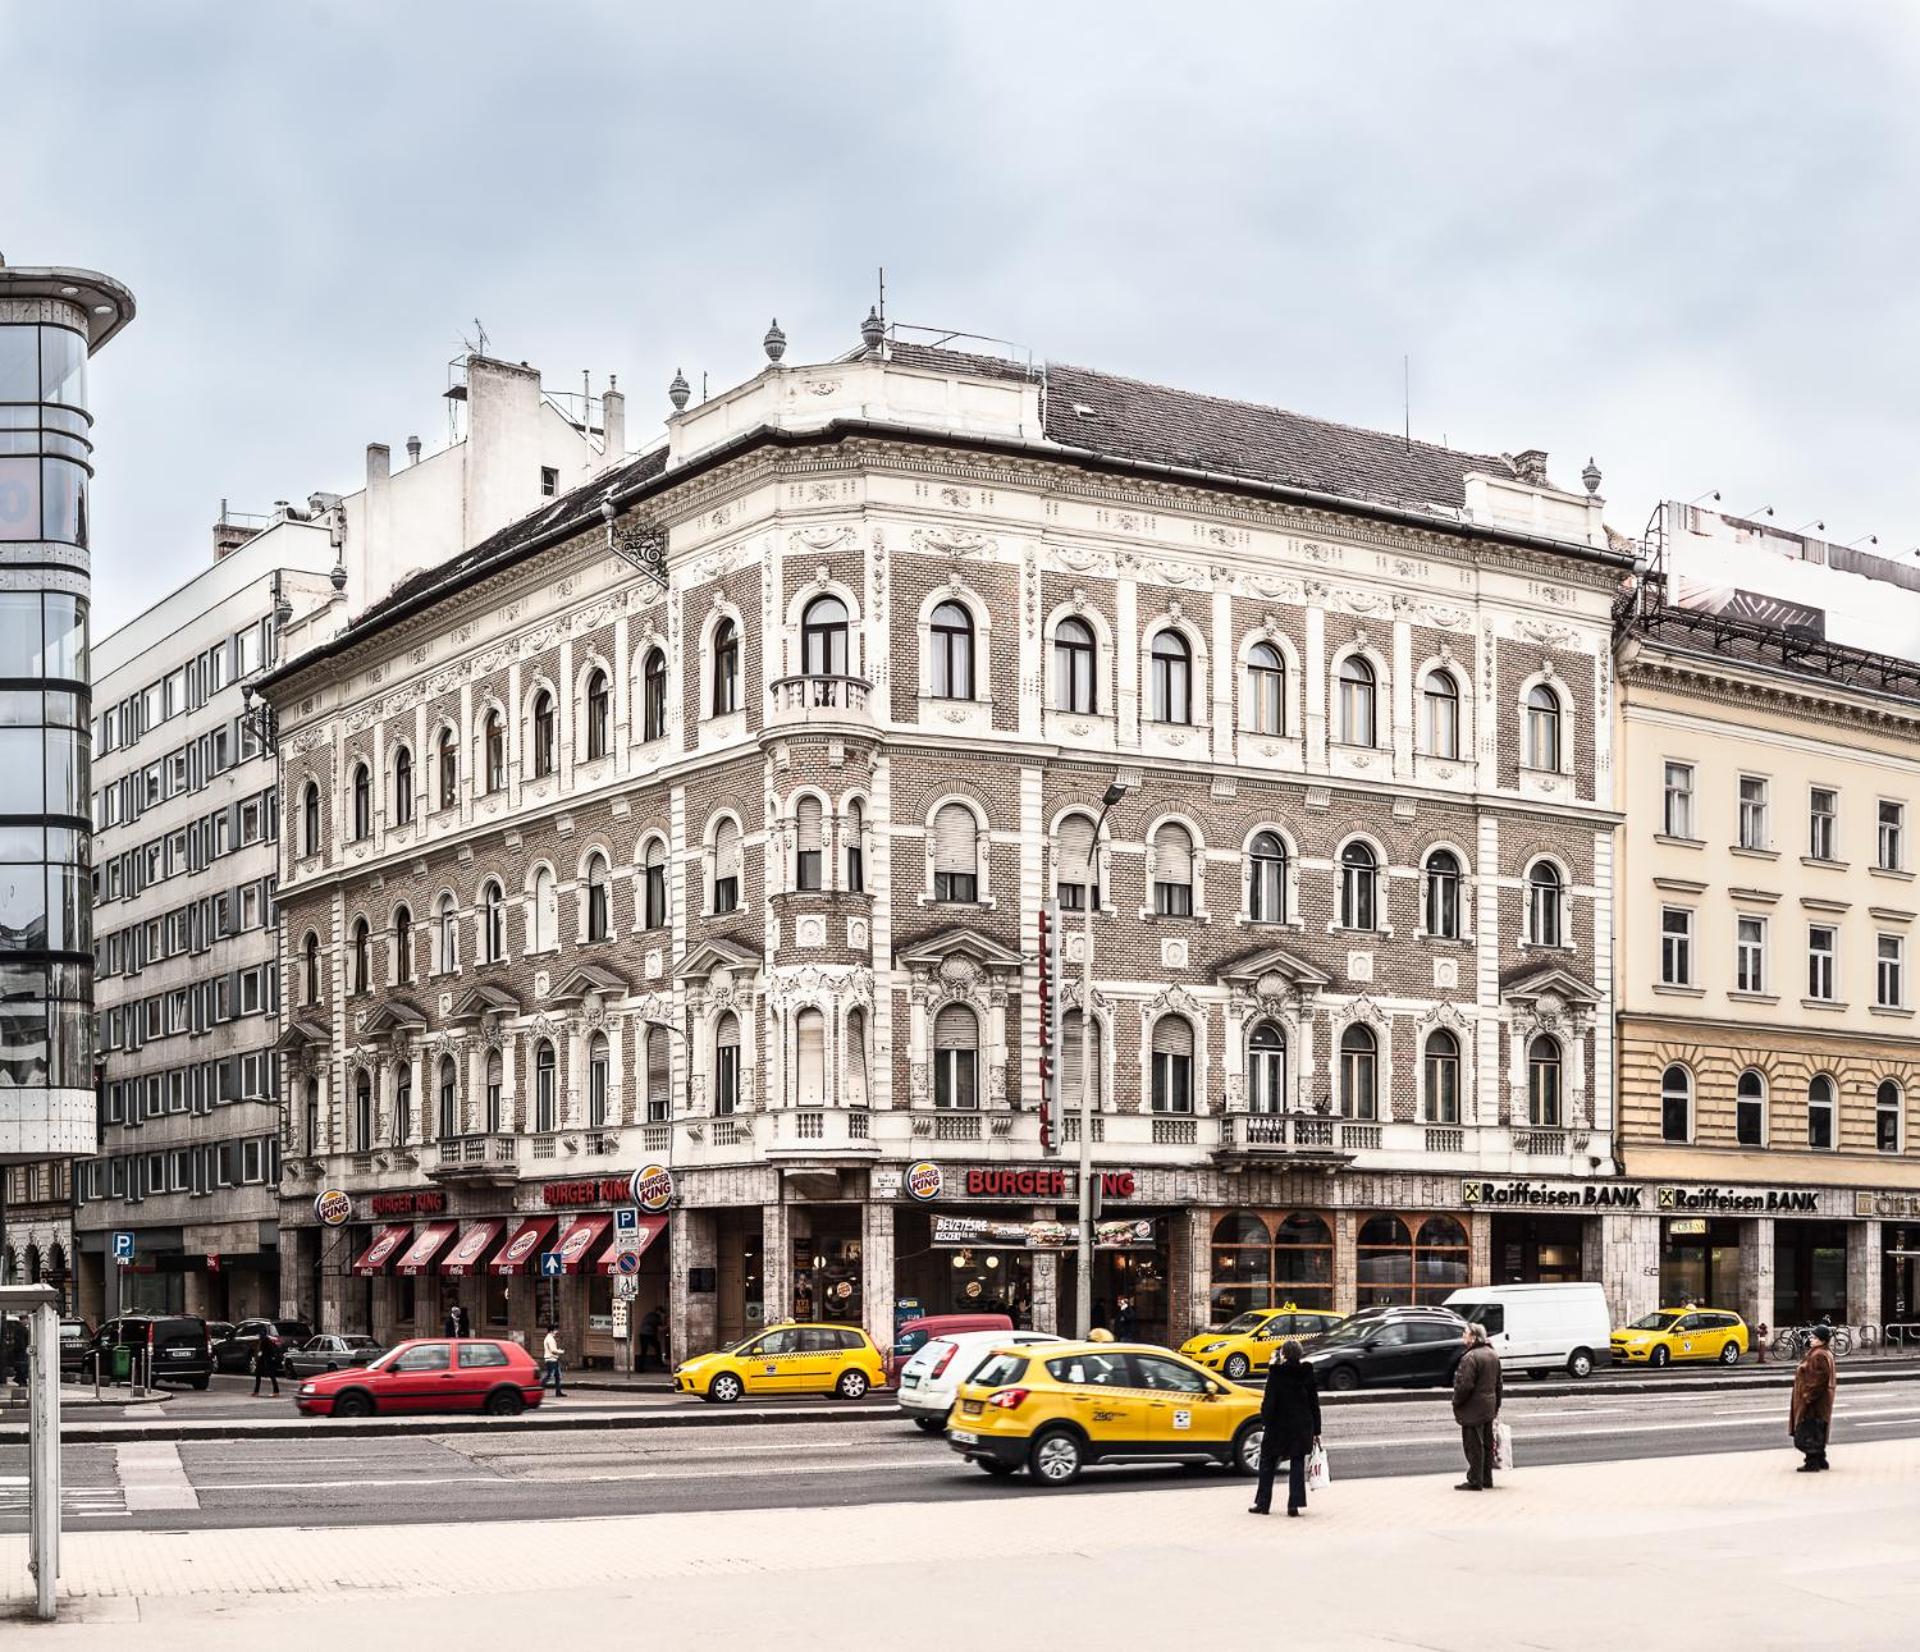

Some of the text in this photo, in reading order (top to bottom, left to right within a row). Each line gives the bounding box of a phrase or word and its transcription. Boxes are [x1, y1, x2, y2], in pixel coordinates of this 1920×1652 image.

[640, 1174, 669, 1191] BURGER
[912, 1170, 939, 1181] BURGER
[912, 1177, 940, 1191] KING
[968, 1170, 1066, 1195] BURGER
[544, 1181, 595, 1204] BURGER
[641, 1182, 671, 1202] KING
[1482, 1183, 1642, 1207] Raiffeisen BANK
[1675, 1188, 1819, 1211] Raiffeisen BANK
[321, 1196, 346, 1210] BURGER
[321, 1203, 349, 1219] KING
[372, 1191, 443, 1214] BURGER KING
[621, 1212, 632, 1227] P
[116, 1235, 131, 1255] P
